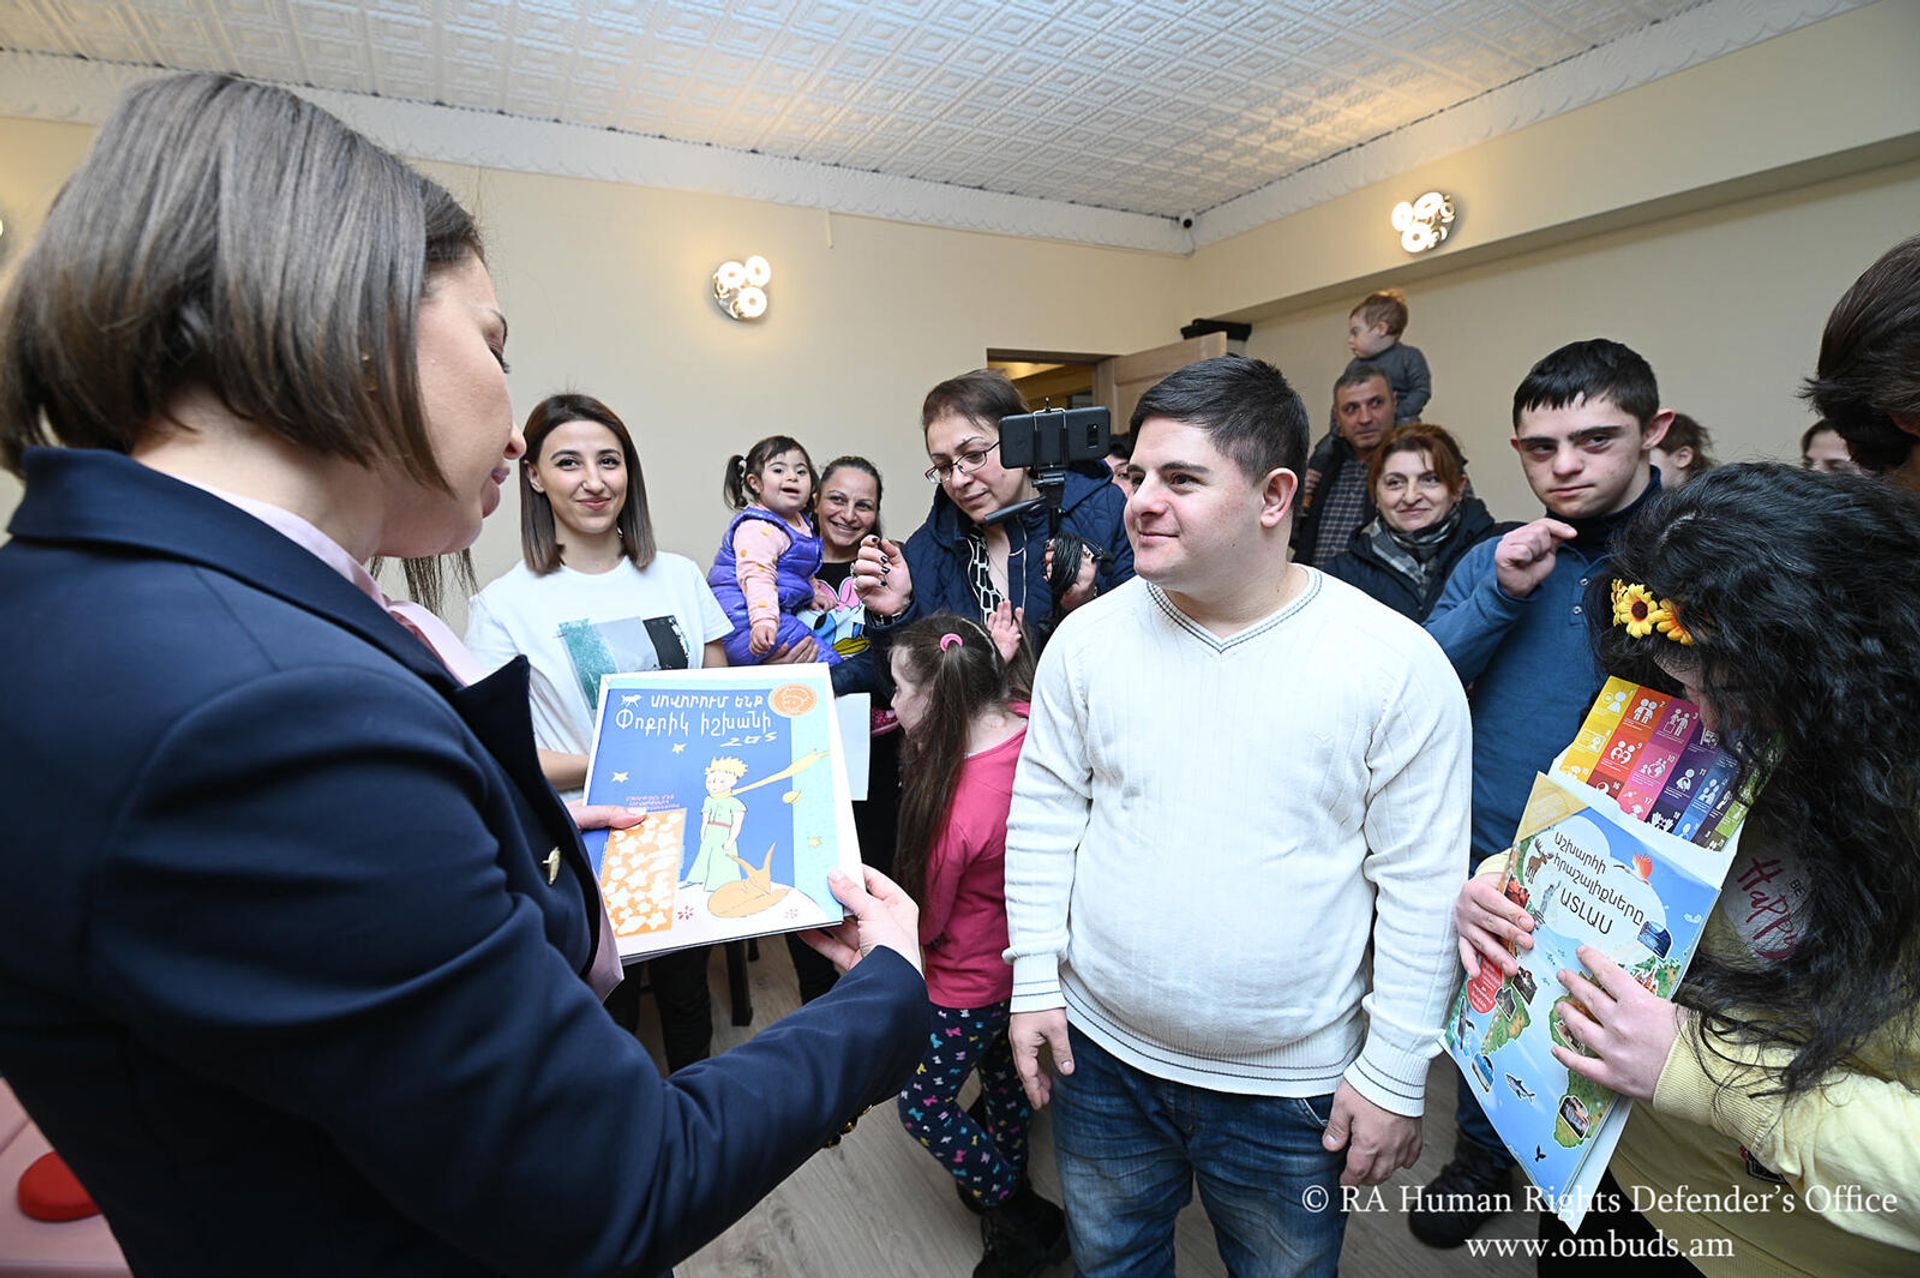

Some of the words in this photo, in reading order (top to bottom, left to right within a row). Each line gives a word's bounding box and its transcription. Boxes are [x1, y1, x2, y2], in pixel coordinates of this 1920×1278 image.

[615, 708, 689, 737] Փոքրիկ
[700, 710, 772, 737] իշխանի
[1554, 831, 1607, 875] Աշխարհի
[1553, 852, 1645, 926] հրաշալիքները
[1560, 887, 1614, 935] ԱՏԼԱՍ
